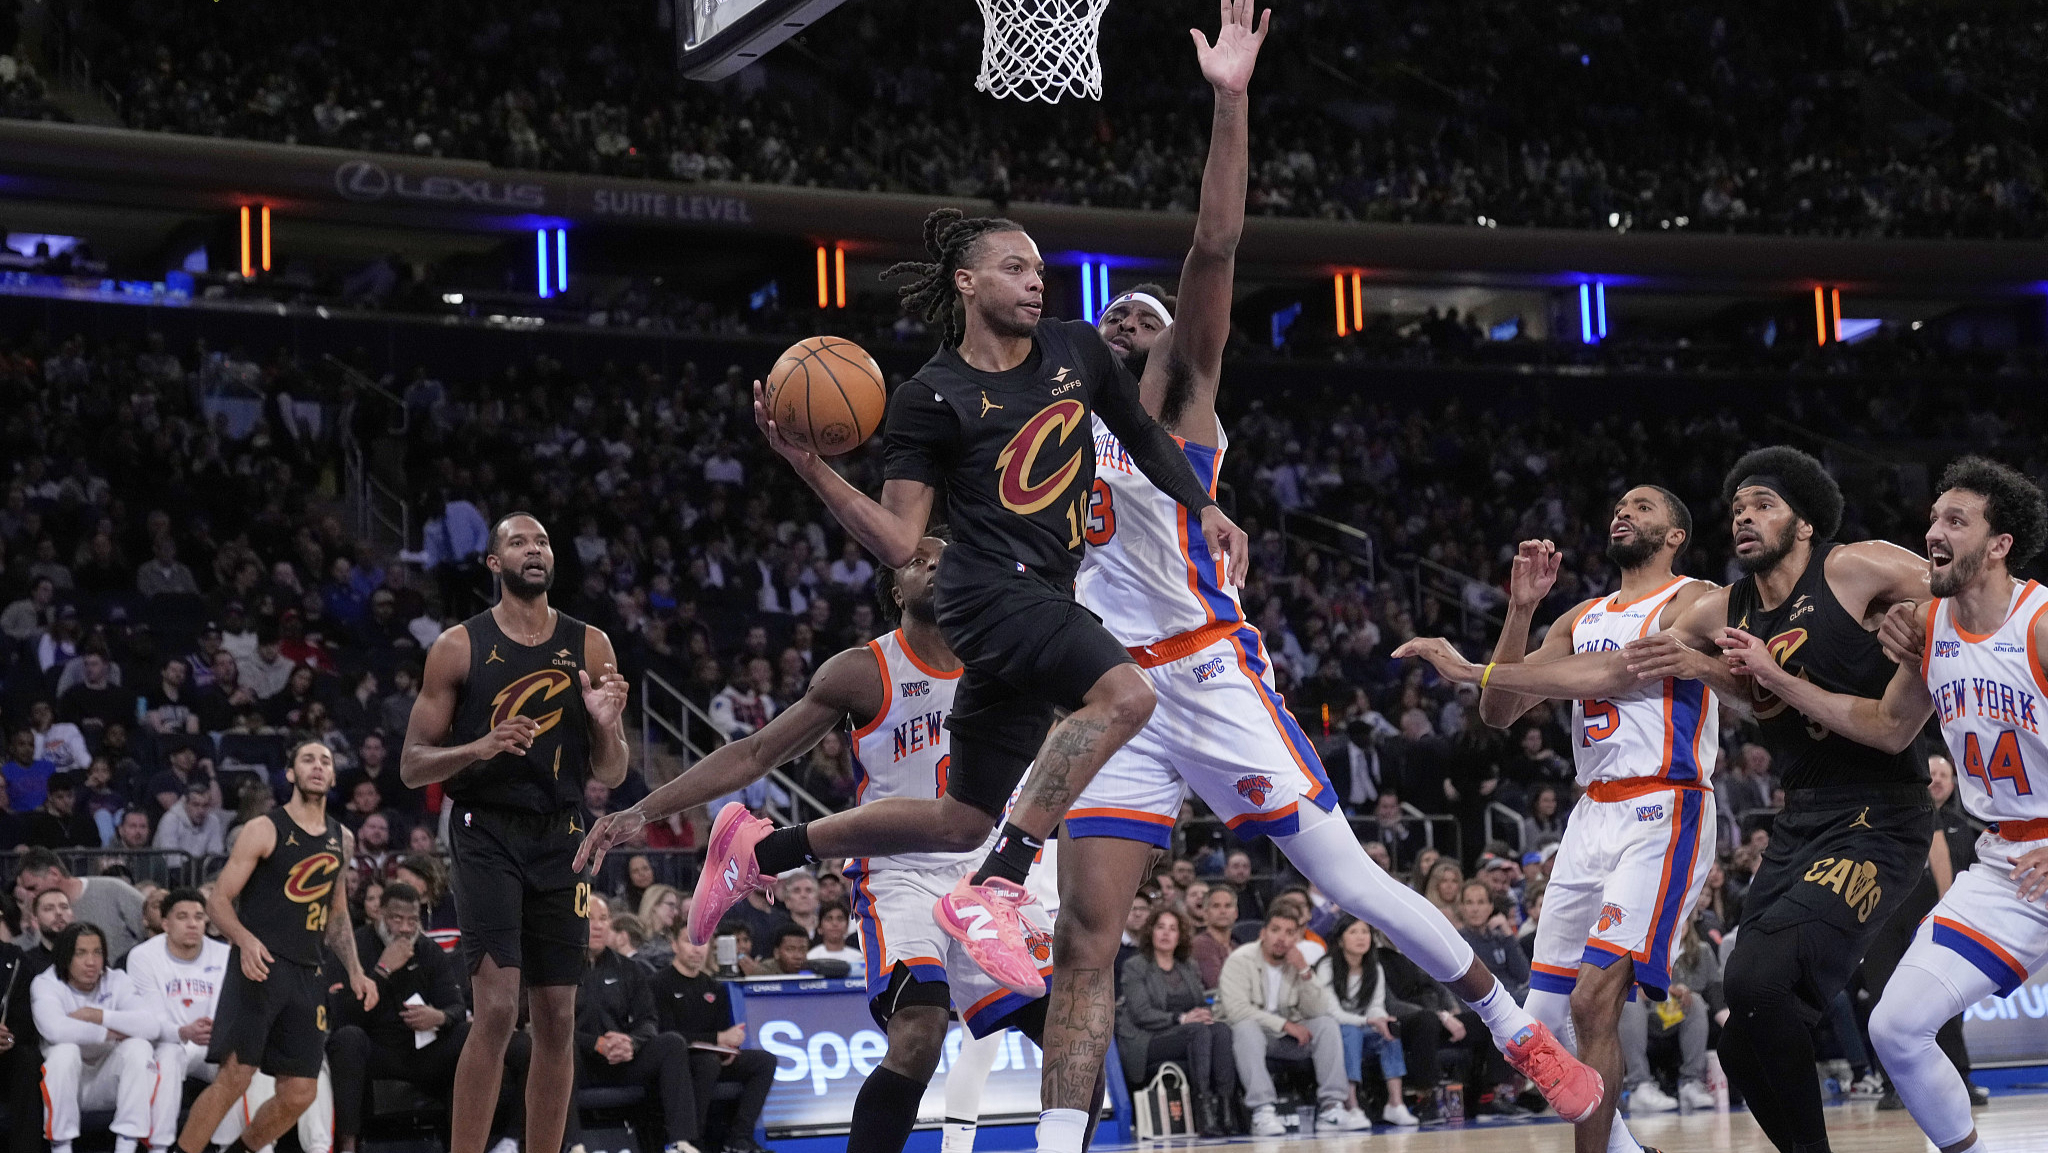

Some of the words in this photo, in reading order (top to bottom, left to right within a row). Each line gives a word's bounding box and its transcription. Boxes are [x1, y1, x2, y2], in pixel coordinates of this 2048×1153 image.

[395, 174, 545, 207] LEXUS
[594, 189, 666, 216] SUITE
[676, 194, 752, 223] LEVEL
[1051, 379, 1082, 396] CLIFFS
[1789, 605, 1815, 622] CLIFFS
[1935, 641, 1961, 658] NYC
[552, 659, 577, 668] CLIFFS
[1193, 657, 1225, 683] NYC
[901, 680, 930, 698] NYC
[1932, 678, 1966, 730] NEW
[1972, 677, 2039, 735] YORK
[893, 709, 943, 763] NEW
[1963, 729, 2033, 798] 44
[1636, 804, 1664, 822] NYC
[1803, 857, 1882, 923] CAVS
